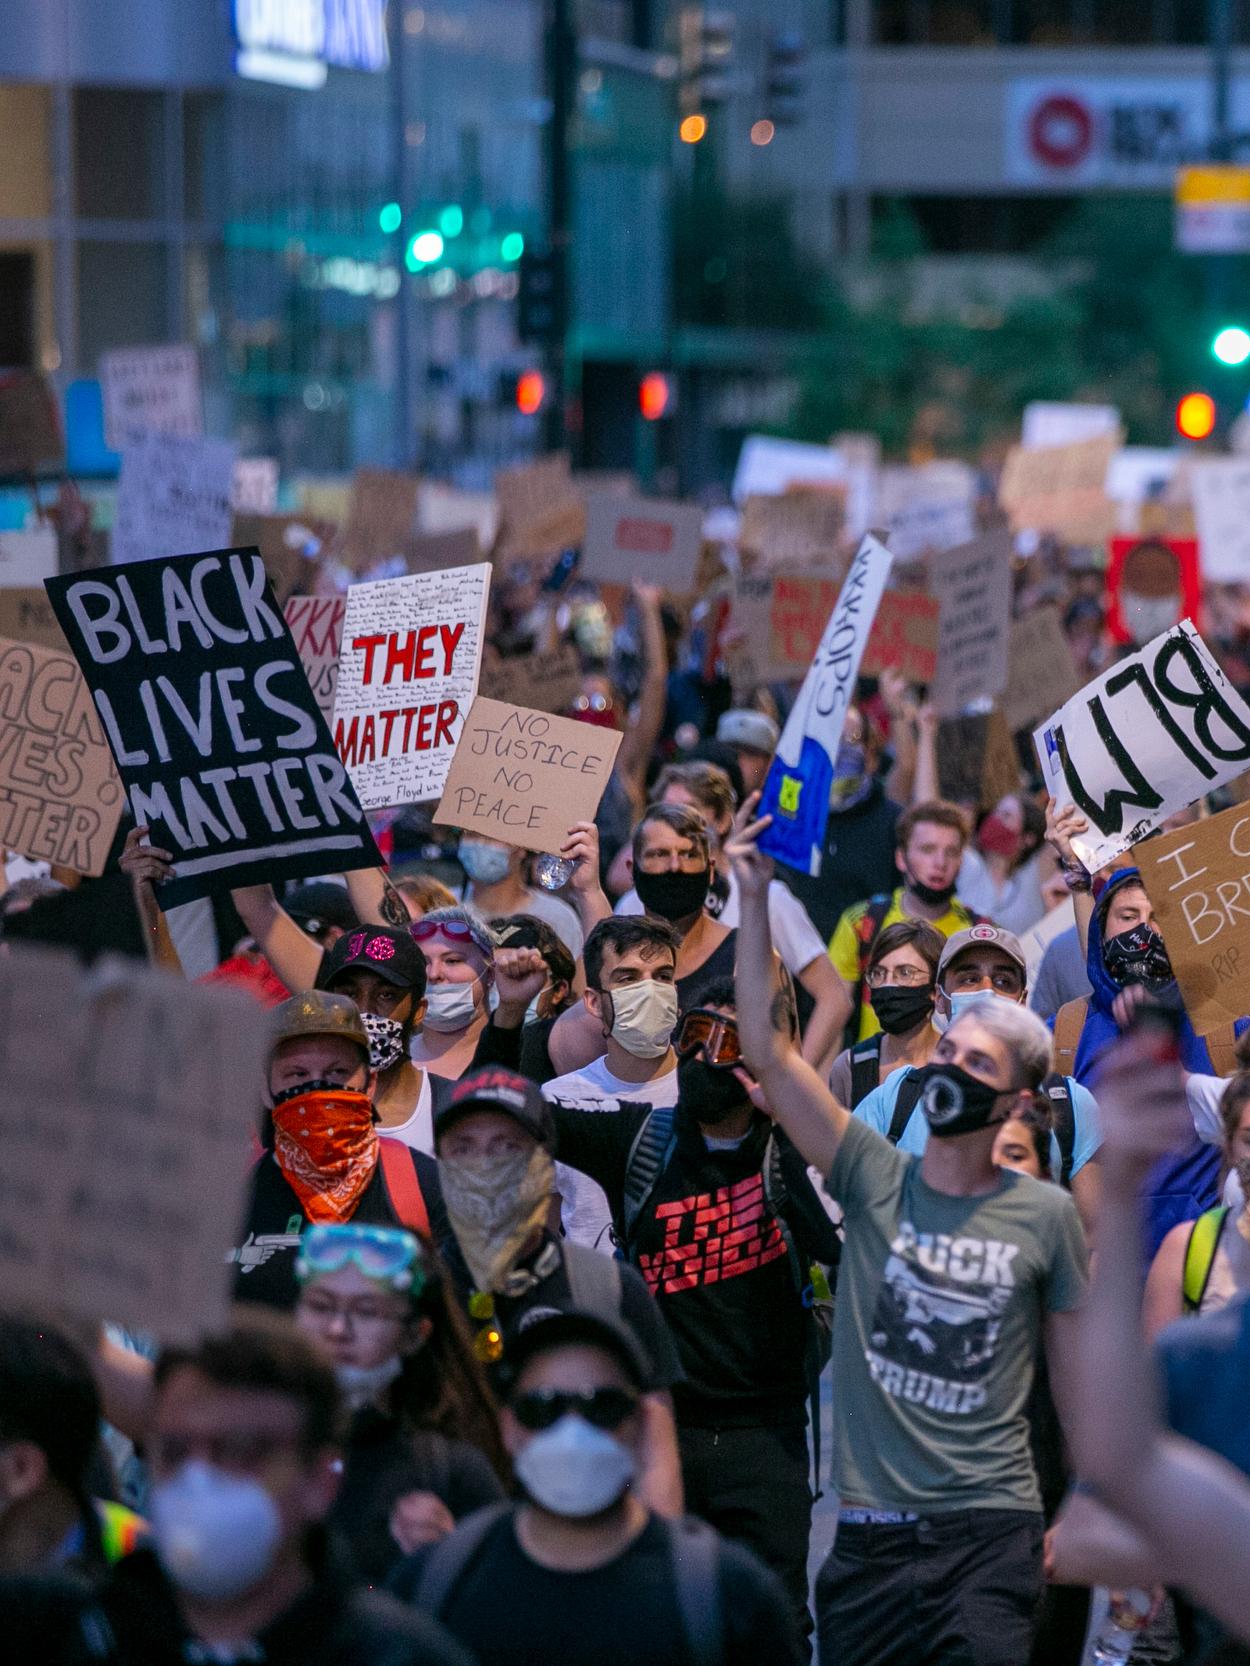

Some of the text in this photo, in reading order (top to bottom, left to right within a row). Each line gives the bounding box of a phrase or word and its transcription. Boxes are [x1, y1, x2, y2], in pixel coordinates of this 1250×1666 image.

[67, 555, 285, 664] BLACK
[352, 623, 465, 685] THEY
[94, 661, 317, 766] LIVES
[335, 700, 459, 768] MATTER
[501, 712, 549, 736] NO
[472, 729, 601, 774] JUSTICE
[130, 754, 361, 850] MATTER
[494, 767, 533, 792] NO
[455, 787, 548, 828] PEACE
[1157, 842, 1207, 891] I
[1212, 945, 1240, 983] RIP
[656, 1172, 764, 1247] THE
